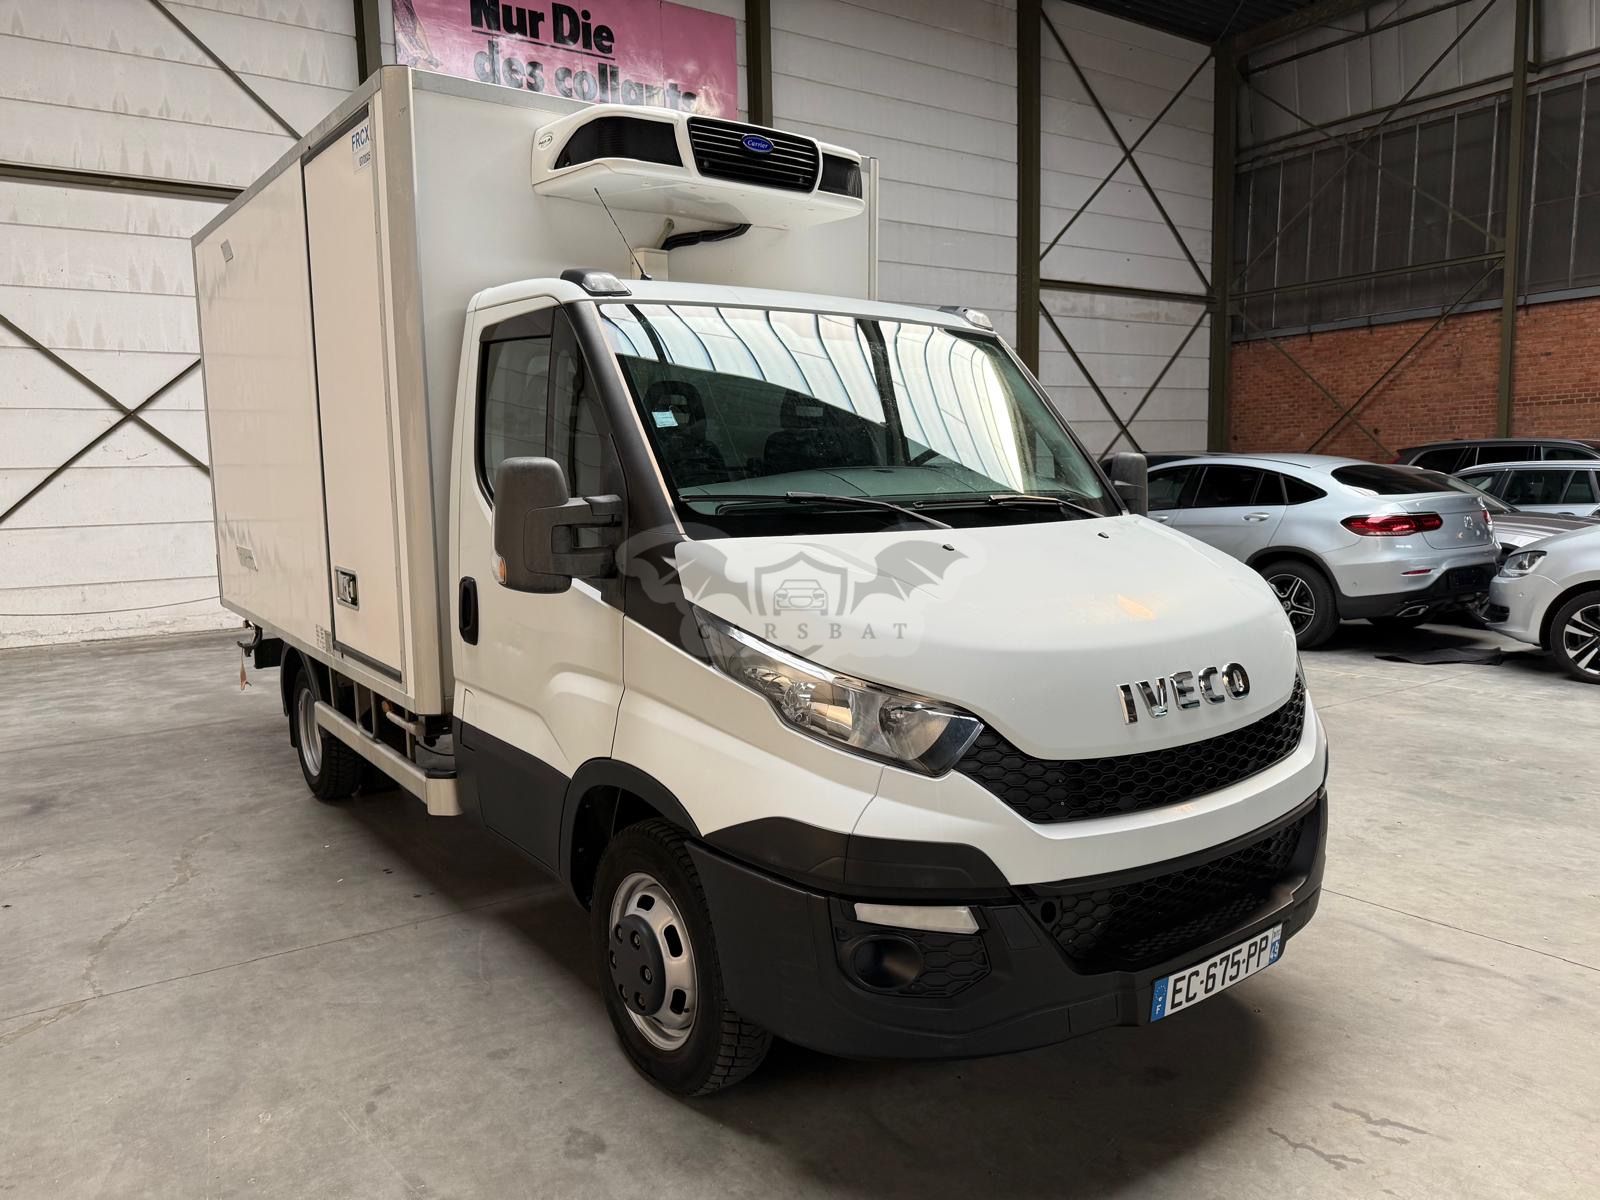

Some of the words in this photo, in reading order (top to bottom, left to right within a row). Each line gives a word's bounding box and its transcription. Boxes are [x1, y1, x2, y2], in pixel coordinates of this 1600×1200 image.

[471, 0, 545, 40] Nur
[552, 2, 615, 54] Die
[473, 37, 544, 92] des
[352, 125, 370, 152] FRCX
[747, 139, 768, 149] Carrier
[1116, 662, 1251, 725] IVECO
[1170, 935, 1269, 1010] EC-675-PP
